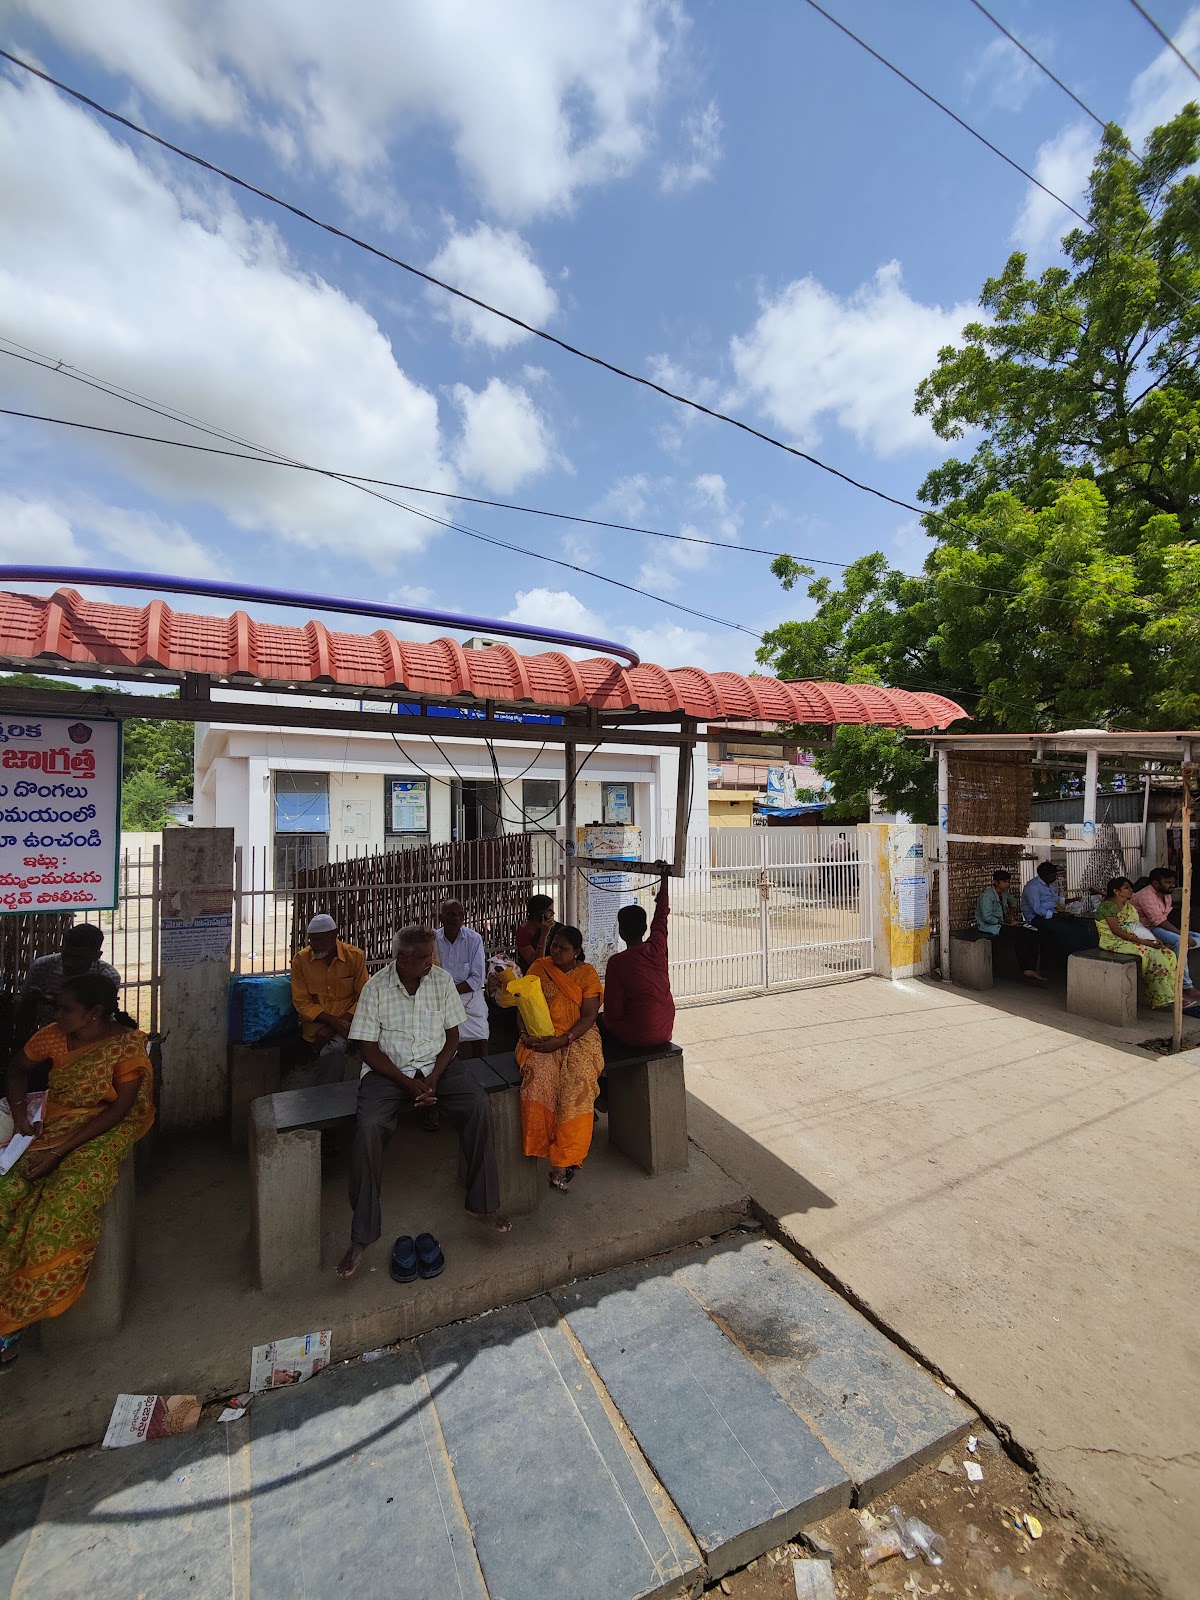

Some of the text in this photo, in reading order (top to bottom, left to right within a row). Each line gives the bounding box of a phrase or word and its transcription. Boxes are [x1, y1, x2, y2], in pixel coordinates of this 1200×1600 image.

[2, 748, 96, 779] జాగ్రత్త
[13, 780, 88, 799] దొంగలు
[23, 829, 102, 848] ఉంచండి
